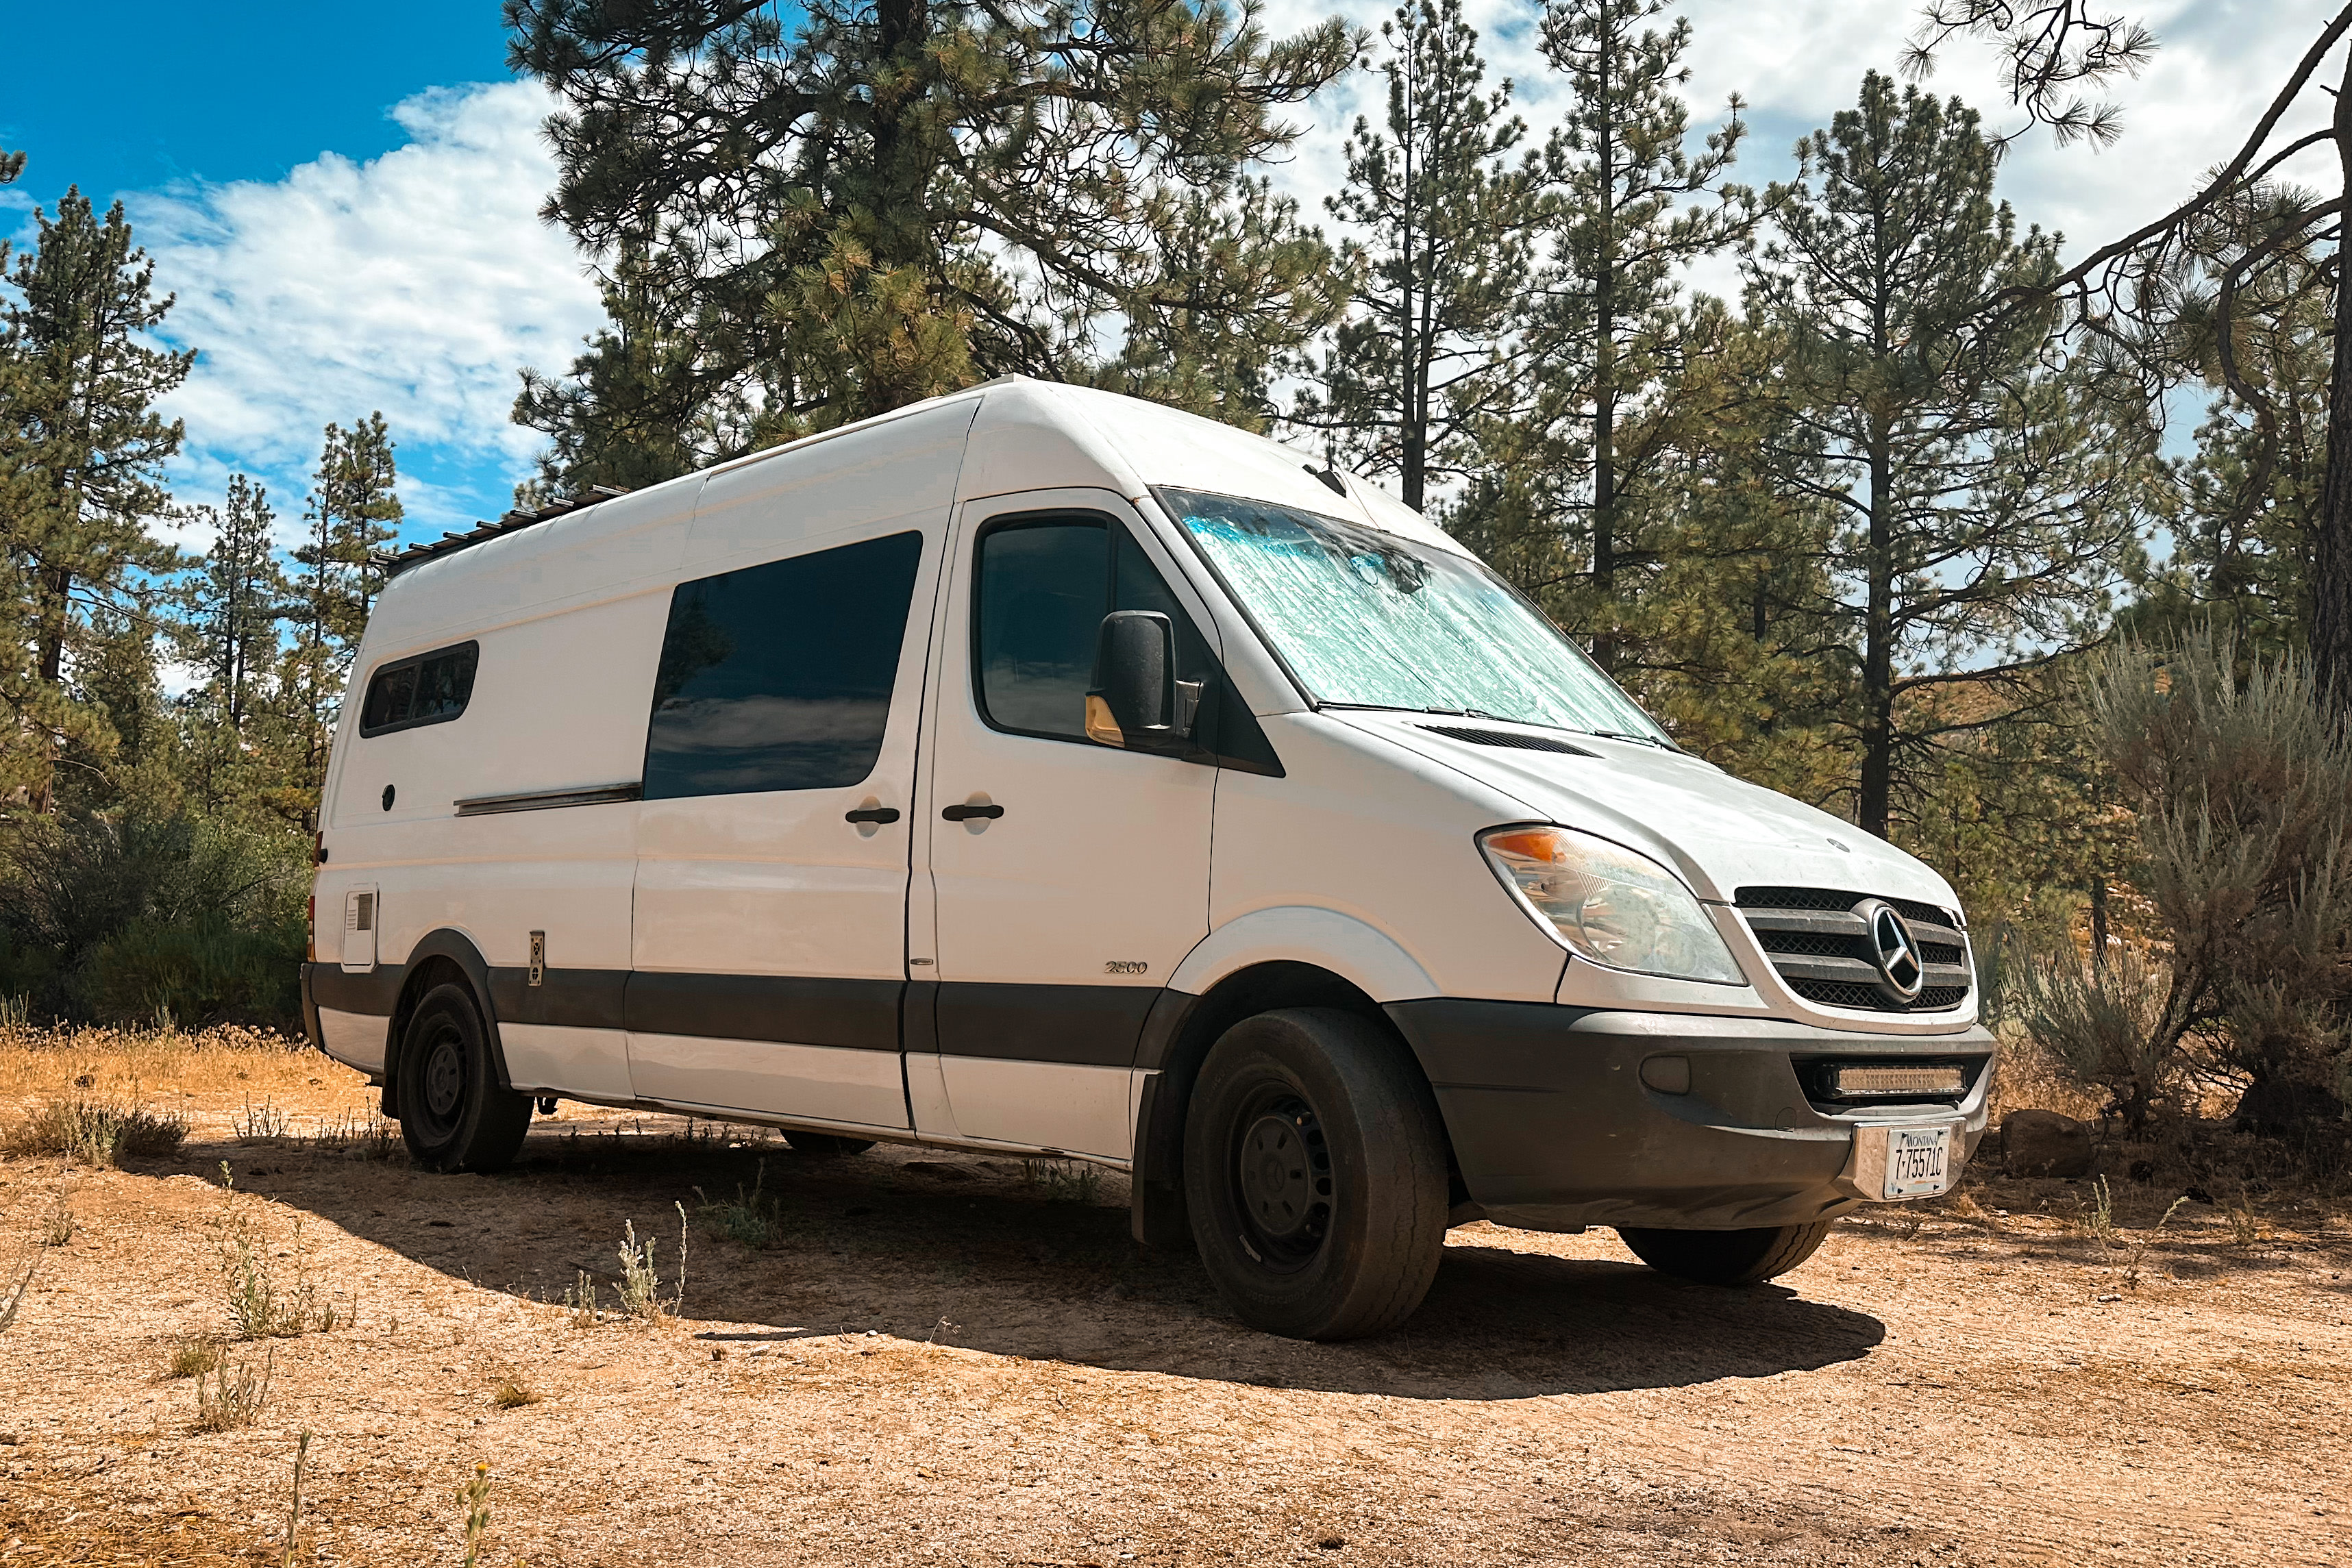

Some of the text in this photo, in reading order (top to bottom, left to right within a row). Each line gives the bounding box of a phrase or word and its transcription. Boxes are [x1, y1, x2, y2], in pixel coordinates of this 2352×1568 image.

[1104, 961, 1148, 974] 2500
[1905, 1134, 1938, 1147] MONTANA
[1896, 1147, 1943, 1180] 7-75571C
